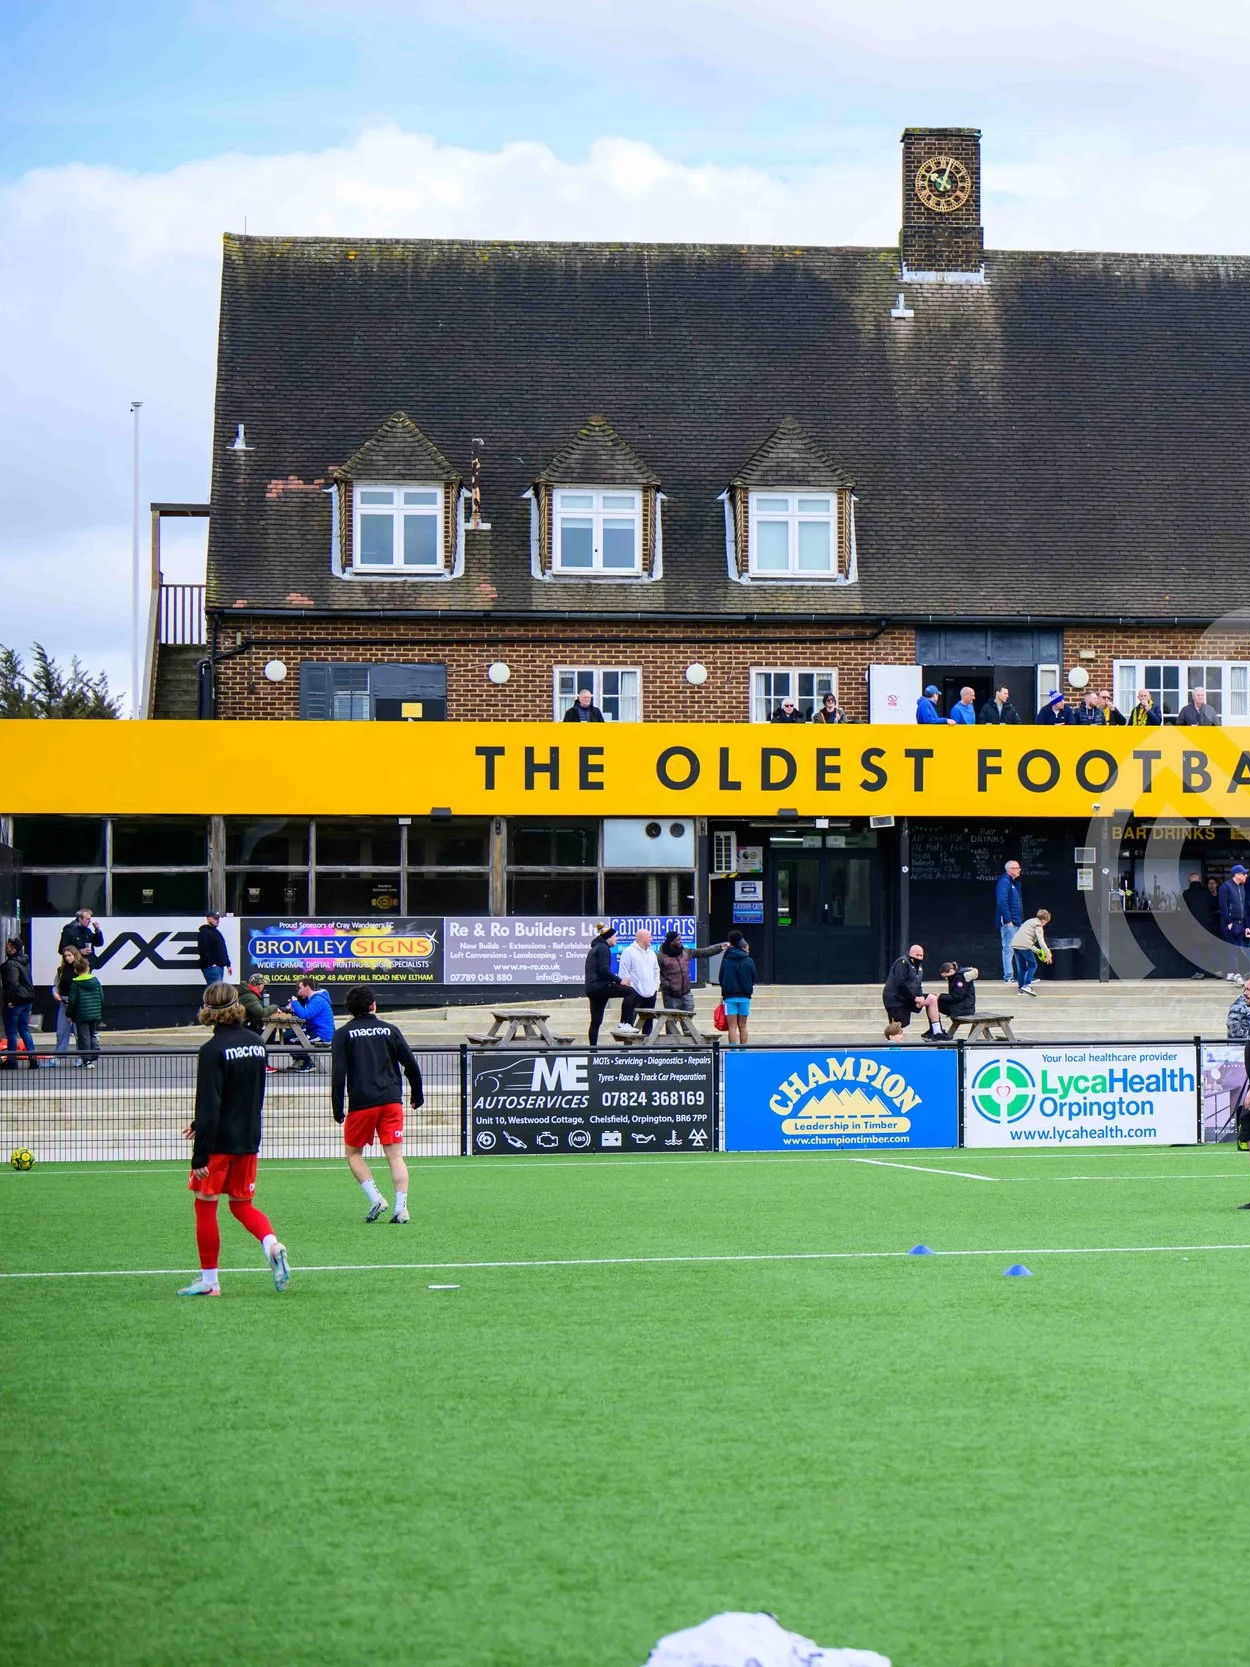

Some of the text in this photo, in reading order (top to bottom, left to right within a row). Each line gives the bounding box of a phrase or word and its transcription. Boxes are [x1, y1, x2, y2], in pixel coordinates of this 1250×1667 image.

[475, 746, 605, 791] THE
[655, 746, 934, 793] OLDEST
[1112, 827, 1216, 840] BAR DRINKS
[970, 836, 1005, 844] DRINKS
[299, 922, 327, 930] Sponsors
[336, 922, 350, 930] Cray
[450, 922, 469, 937] Re
[473, 922, 486, 937] &
[491, 922, 510, 937] Ro
[514, 922, 576, 937] Builders
[255, 940, 429, 954] BROMLEY SIGNS
[460, 942, 478, 950] New
[478, 942, 499, 950] Builds
[509, 942, 546, 950] Extensions
[514, 952, 556, 960] Landscaping
[257, 961, 275, 969] WIDE
[276, 961, 304, 969] FORMAT
[306, 961, 331, 969] DIGITAL
[333, 961, 363, 969] PRINTING
[391, 960, 430, 968] SPECIALISTS
[493, 962, 560, 971] www.re-ro.co.uk
[271, 974, 292, 982] LOCAL
[450, 974, 512, 982] 07789 043 880
[349, 1027, 391, 1038] macron
[225, 1046, 266, 1060] macron
[1042, 1052, 1178, 1063] Your local healthcare provider
[592, 1056, 711, 1067] MOTs Servicing Diagnostics Repairs
[530, 1057, 590, 1091] ME
[598, 1074, 614, 1082] Tyres
[618, 1073, 634, 1081] Race
[640, 1073, 657, 1081] Track
[658, 1073, 669, 1081] Car
[670, 1072, 706, 1082] Preparation
[769, 1057, 922, 1116] CHAMPION
[1040, 1067, 1195, 1100] LycaHealth
[473, 1095, 590, 1109] AUTOSERVICES
[602, 1091, 704, 1107] 07824 368169
[1040, 1096, 1154, 1121] Orpington
[476, 1116, 584, 1126] Unit 10, Westwood Cottage,
[590, 1114, 708, 1125] Chelsfield, Orpington, BR6 7PP
[794, 1121, 898, 1132] Leadership in Timber
[1010, 1126, 1156, 1142] www.lycahealth.com
[782, 1134, 910, 1147] www.championtimber.com
